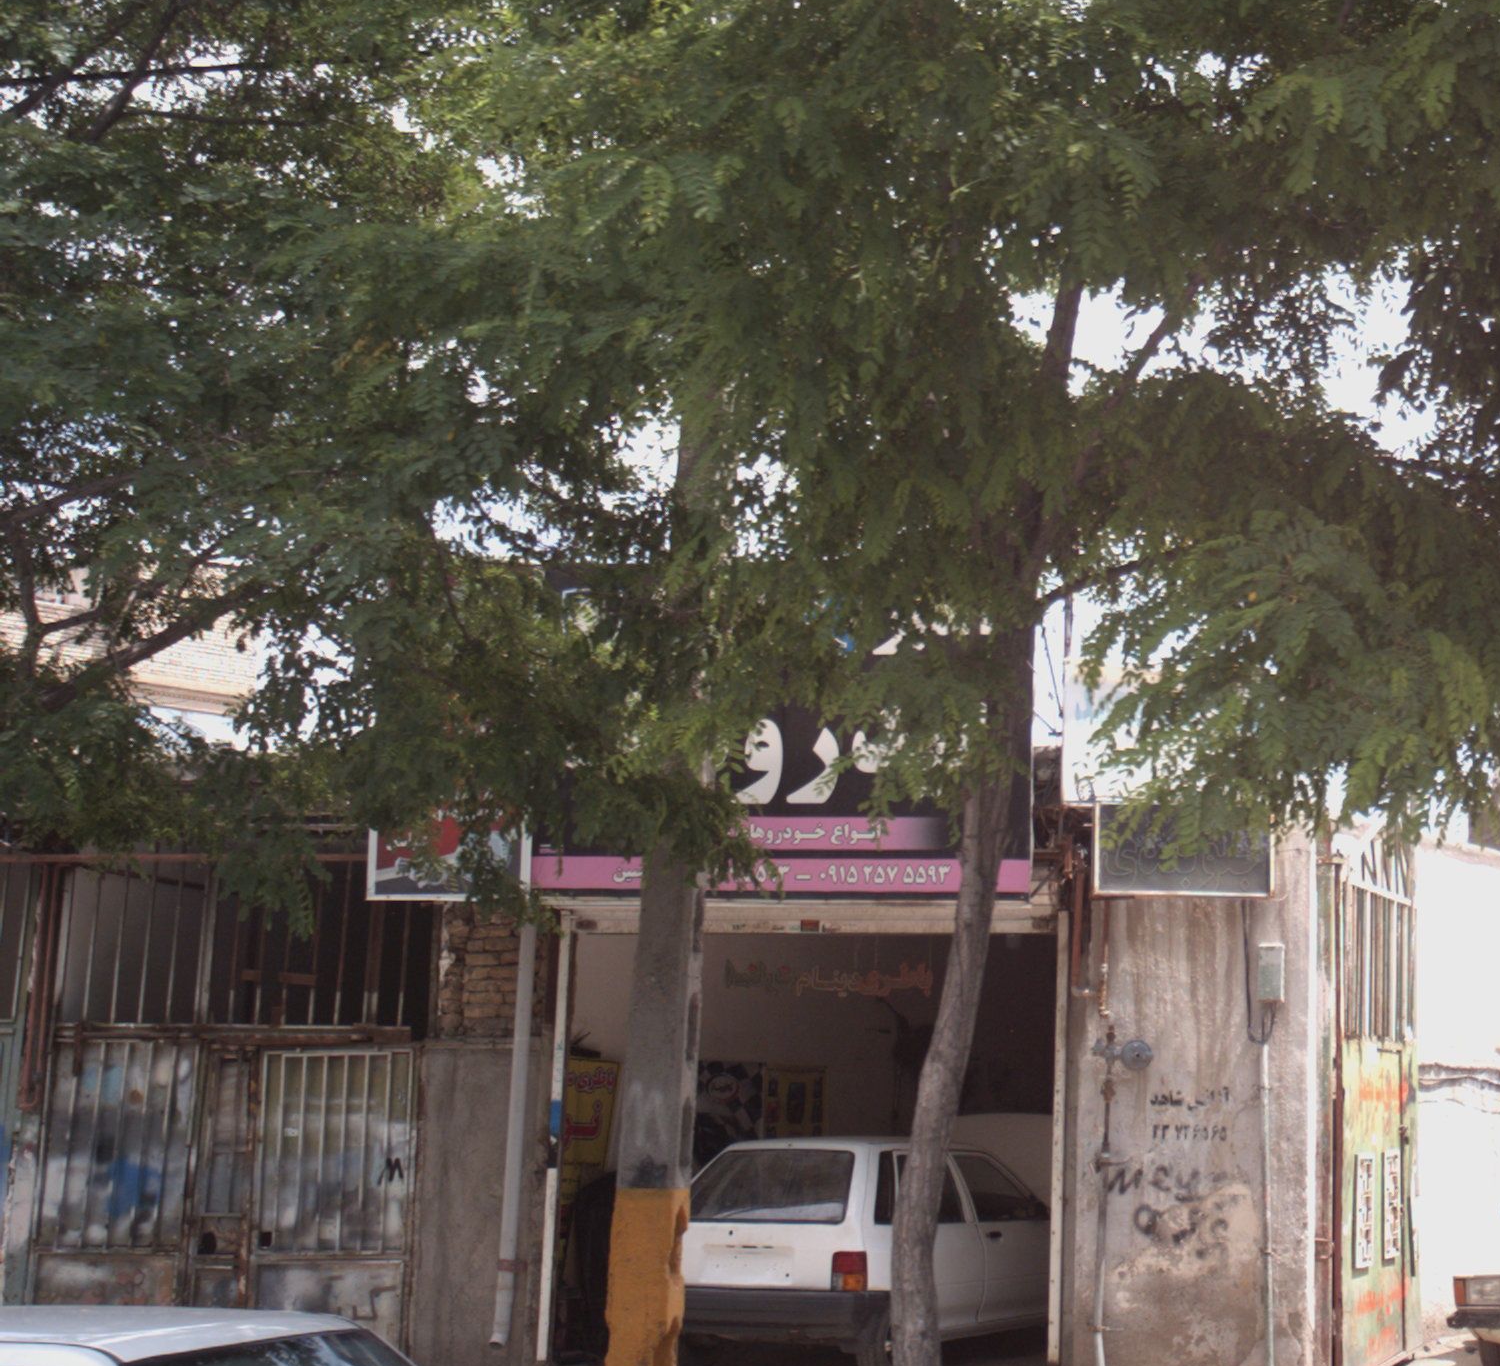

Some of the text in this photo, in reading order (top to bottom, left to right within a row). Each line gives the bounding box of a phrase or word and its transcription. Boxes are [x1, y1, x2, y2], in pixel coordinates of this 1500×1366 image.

[748, 822, 827, 845] خودروها
[820, 863, 858, 885] ۰۹۱۵
[902, 863, 951, 885] ۵۵۹۳
